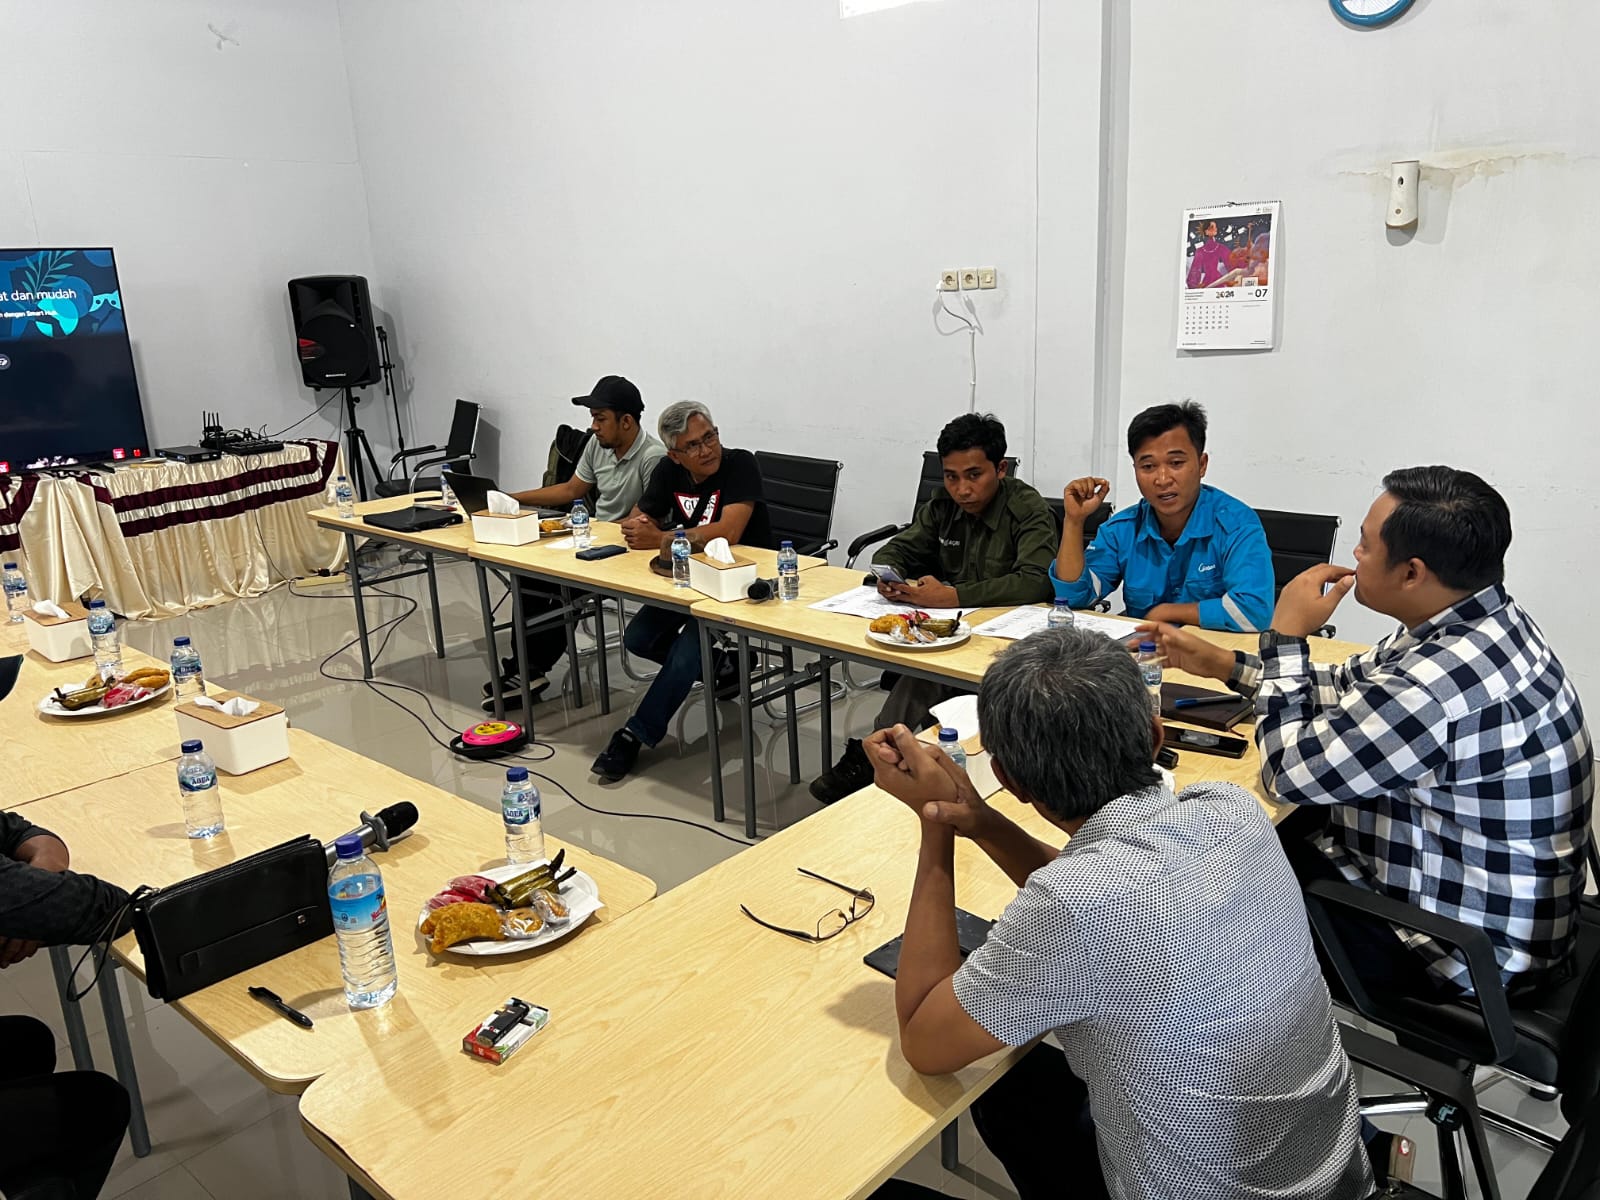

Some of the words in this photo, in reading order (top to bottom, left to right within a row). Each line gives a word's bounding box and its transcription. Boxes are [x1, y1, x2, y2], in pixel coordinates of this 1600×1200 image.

[11, 290, 34, 301] dan
[36, 288, 77, 300] mudah
[1215, 290, 1235, 299] 2024
[1254, 288, 1268, 298] 07
[191, 775, 210, 785] AQUA
[506, 809, 524, 817] AQUA
